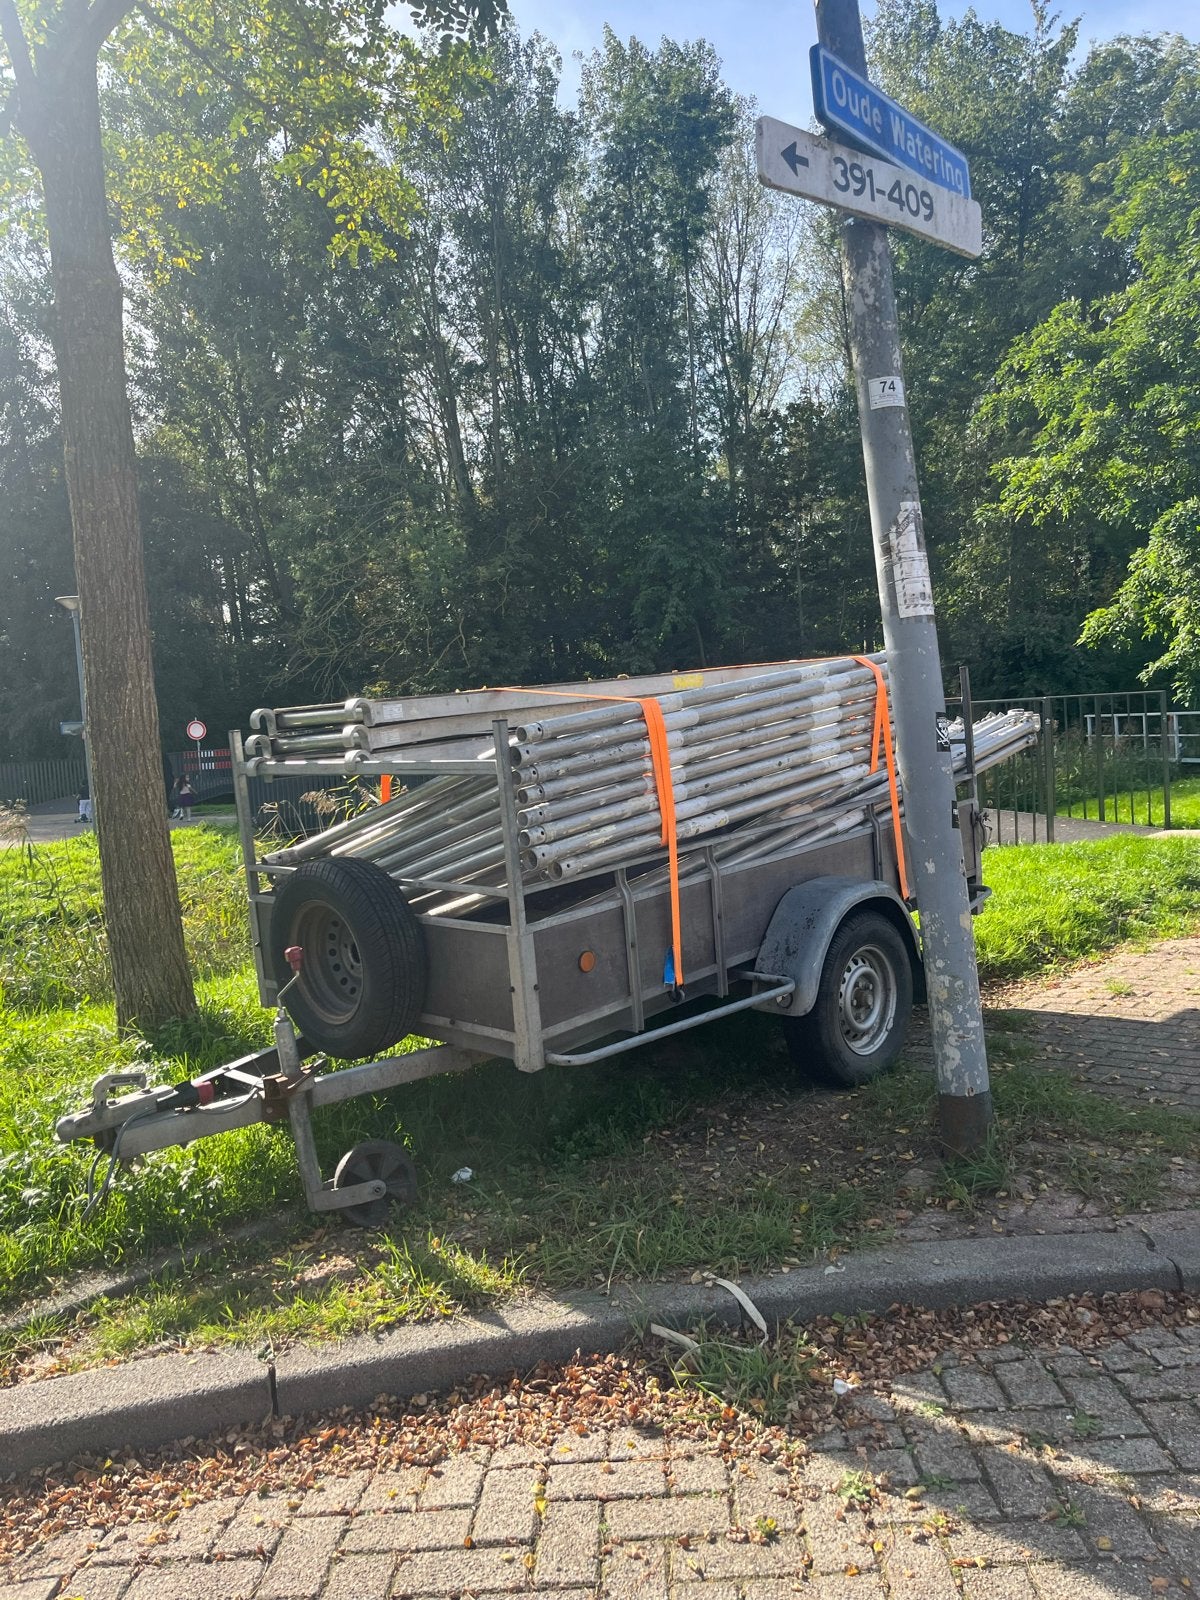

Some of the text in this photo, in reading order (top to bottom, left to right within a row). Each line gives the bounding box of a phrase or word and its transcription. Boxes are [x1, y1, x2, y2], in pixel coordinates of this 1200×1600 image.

[832, 69, 964, 196] Oude Watering
[833, 156, 934, 222] 391-409
[879, 380, 896, 393] 74
